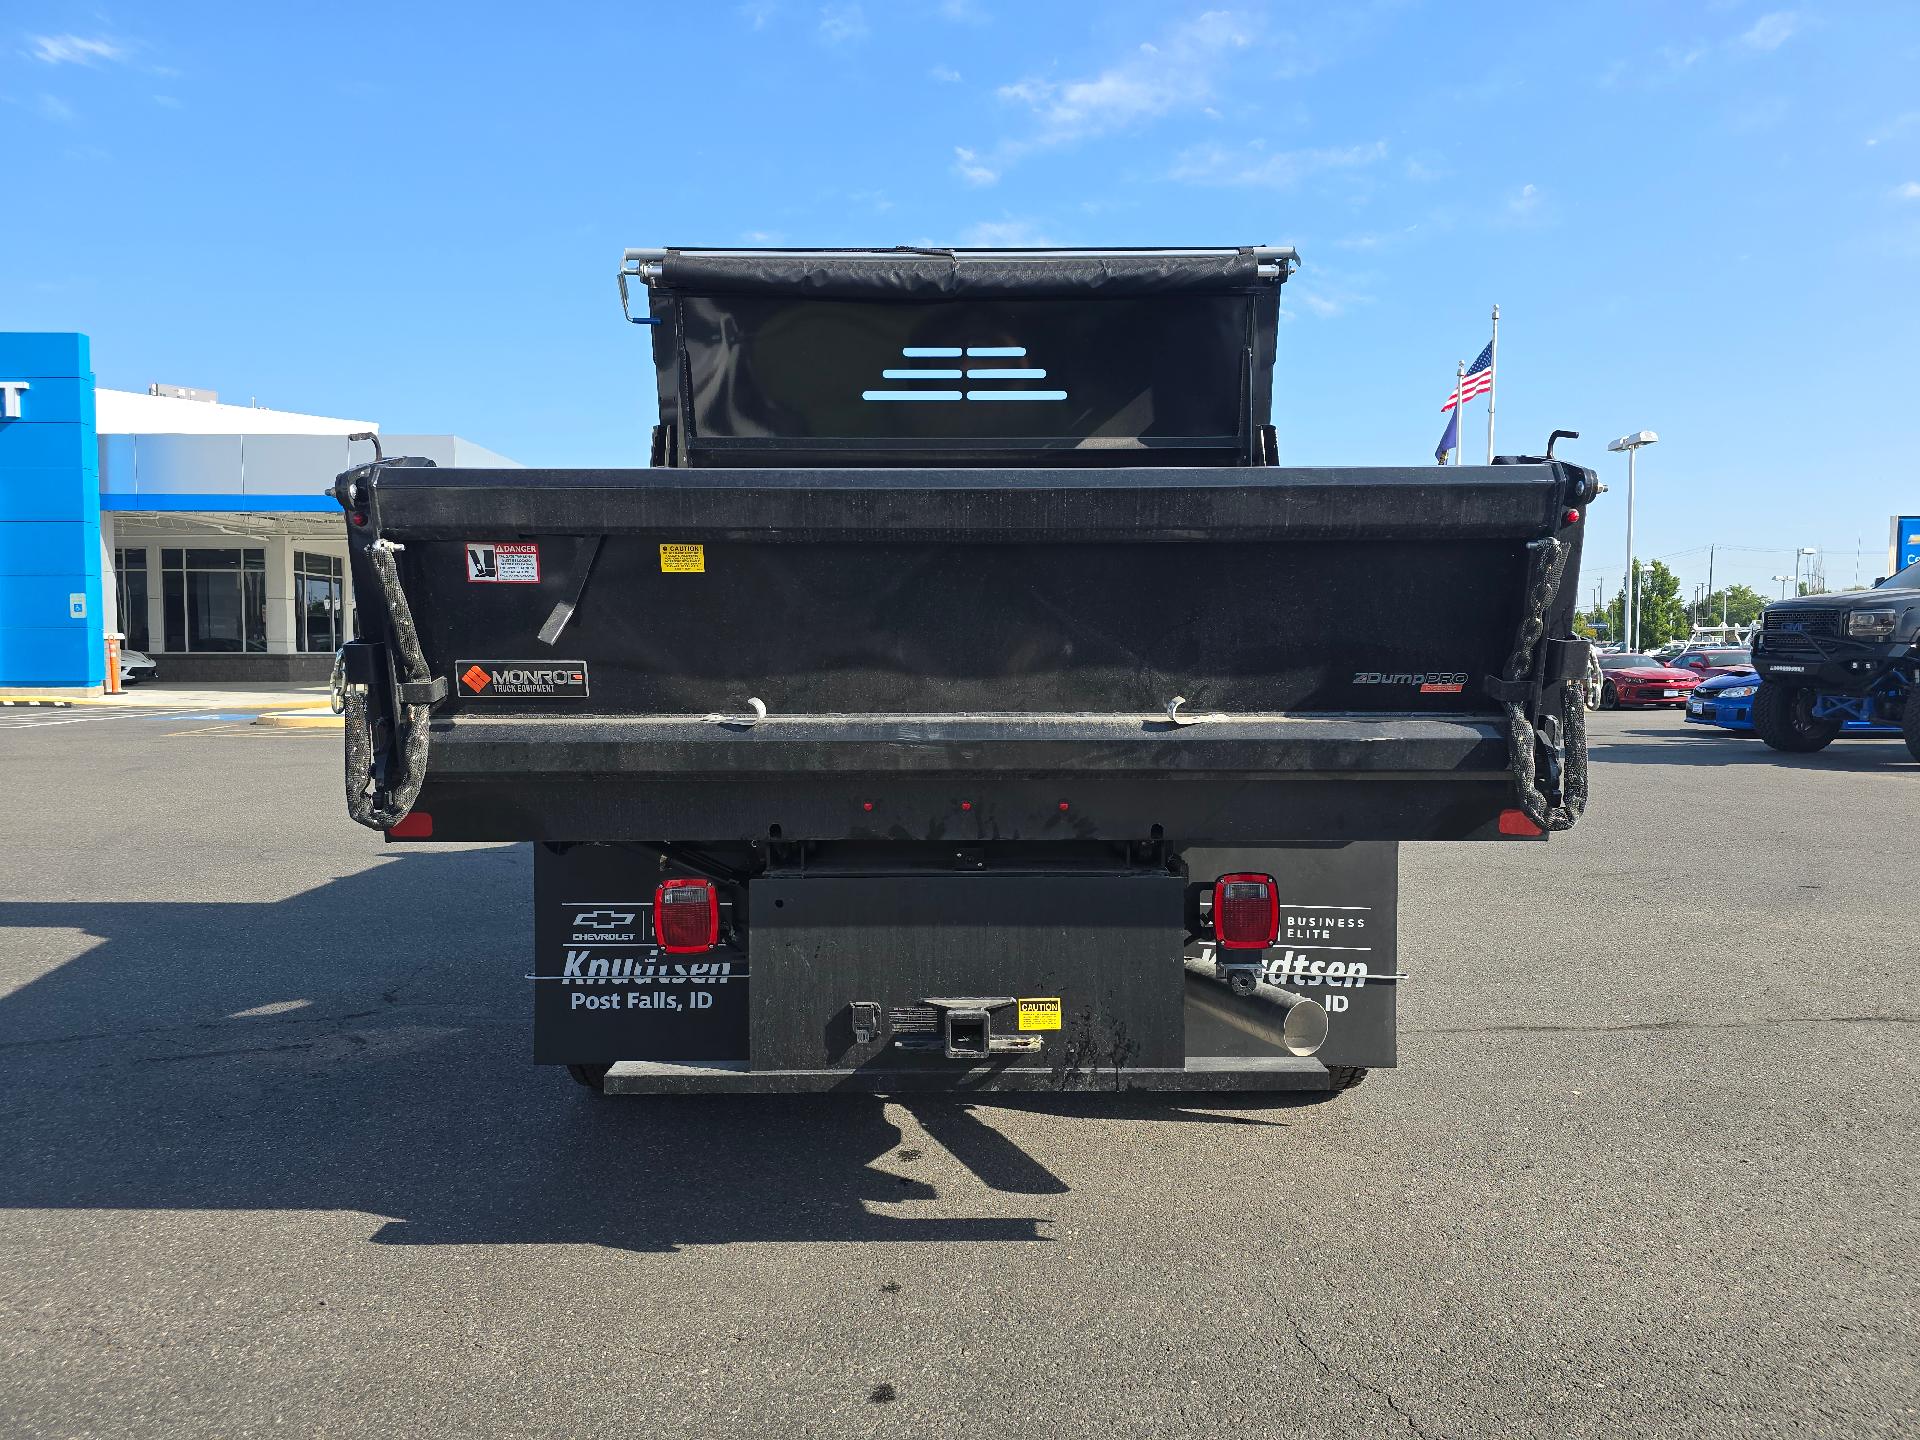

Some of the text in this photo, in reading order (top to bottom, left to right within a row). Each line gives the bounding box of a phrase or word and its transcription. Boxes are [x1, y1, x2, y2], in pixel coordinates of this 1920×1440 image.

[503, 545, 537, 553] DANGER
[491, 670, 583, 685] MONROE
[494, 684, 555, 693] TRUCK EQUIPMENT
[1287, 916, 1365, 928] BUSINESS
[572, 933, 635, 941] CHEVROLET
[1287, 929, 1330, 939] ELITE
[571, 991, 713, 1012] Post Falls, ID
[1325, 994, 1349, 1012] ID
[1021, 1003, 1058, 1011] CAUTION
